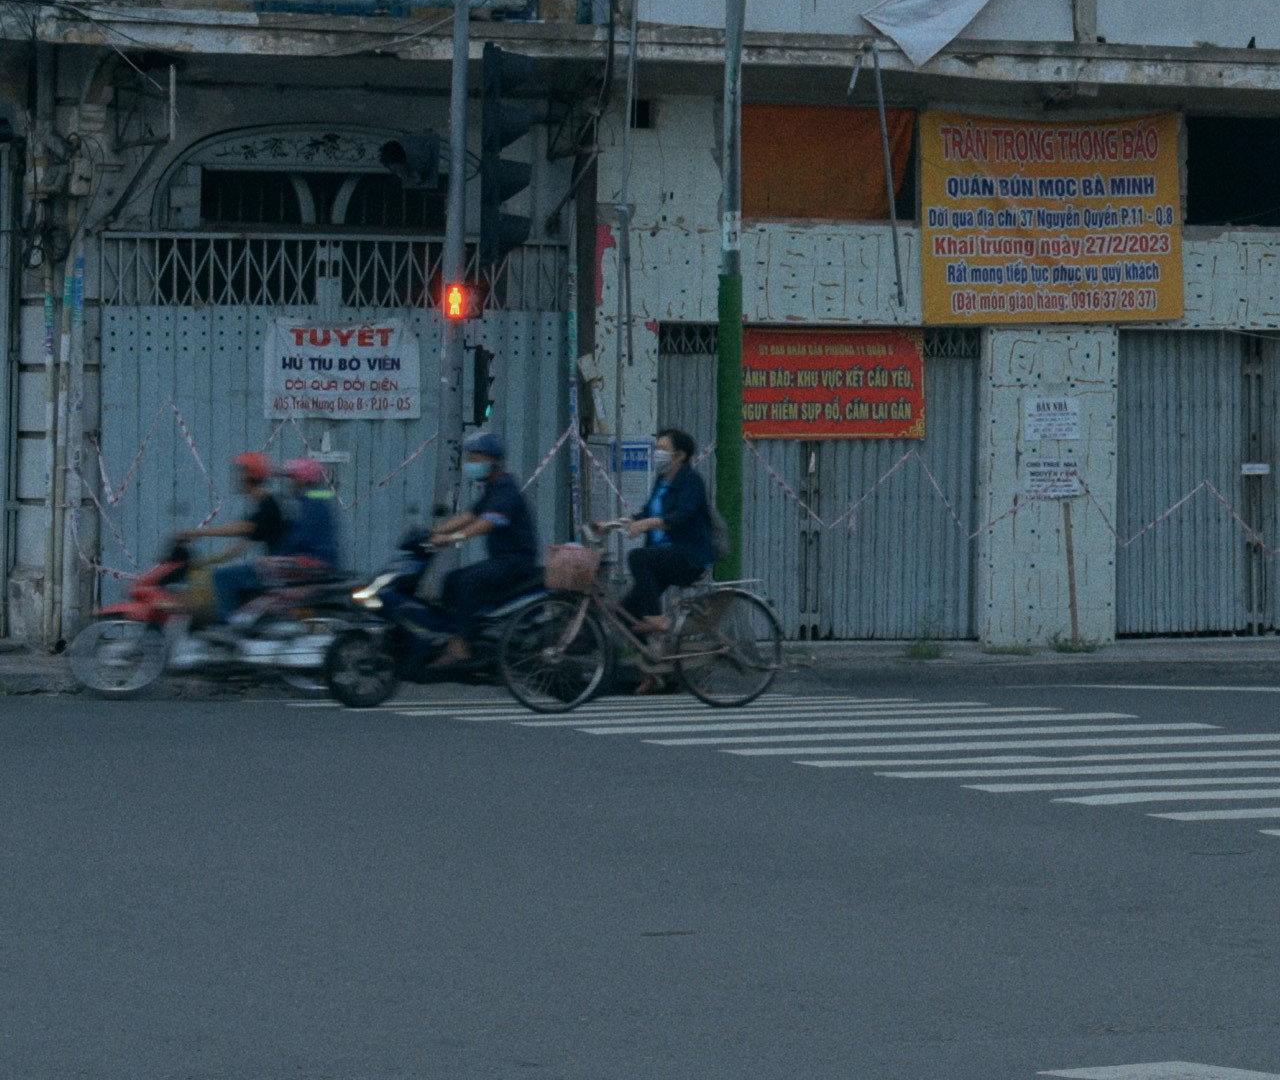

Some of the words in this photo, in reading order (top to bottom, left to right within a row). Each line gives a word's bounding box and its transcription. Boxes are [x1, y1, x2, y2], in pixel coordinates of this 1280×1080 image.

[992, 127, 1054, 168] TRỌNG
[1058, 124, 1118, 160] THÔNG
[1122, 122, 1159, 160] BÁO
[947, 172, 994, 197] QUÁN
[1000, 173, 1033, 197] BÚN
[1039, 177, 1077, 201] MỌC
[1082, 173, 1106, 197] BÀ
[1111, 176, 1155, 196] MINH
[952, 211, 974, 229] qua
[998, 207, 1017, 227] chỉ
[1020, 209, 1034, 227] 37
[1121, 209, 1143, 226] P.11
[934, 236, 974, 255] Khai
[980, 237, 1035, 257] trương
[1040, 237, 1080, 257] ngày
[1086, 234, 1170, 254] 27/2/2023
[947, 261, 967, 283] Rất
[971, 267, 1003, 284] mong
[1006, 261, 1028, 285] tiếp
[1031, 264, 1049, 286] tục
[1052, 263, 1082, 286] phục
[1085, 267, 1099, 285] vụ
[1102, 263, 1122, 283] quý
[1125, 262, 1160, 281] khách
[980, 292, 1005, 310] món
[1009, 293, 1034, 312] giao
[1072, 291, 1100, 310] 0916
[1103, 291, 1118, 309] 37
[1120, 290, 1136, 309] 28
[1138, 289, 1157, 310] 37)
[290, 323, 394, 347] TUYẾT
[282, 353, 303, 370] HỦ
[338, 354, 361, 371] BÒ
[367, 354, 400, 371] VIÊN
[311, 378, 338, 391] QUA
[742, 366, 767, 387] ẢNH
[770, 366, 795, 387] BÁO:
[797, 370, 818, 388] KHU
[821, 369, 843, 391] VỰC
[845, 365, 866, 388] KẾT
[867, 365, 889, 388] CẤU
[771, 396, 799, 420] HIỂM
[801, 402, 822, 423] SỤP
[845, 396, 869, 420] CẤM
[872, 402, 889, 422] LẠI
[890, 397, 912, 420] GẦN
